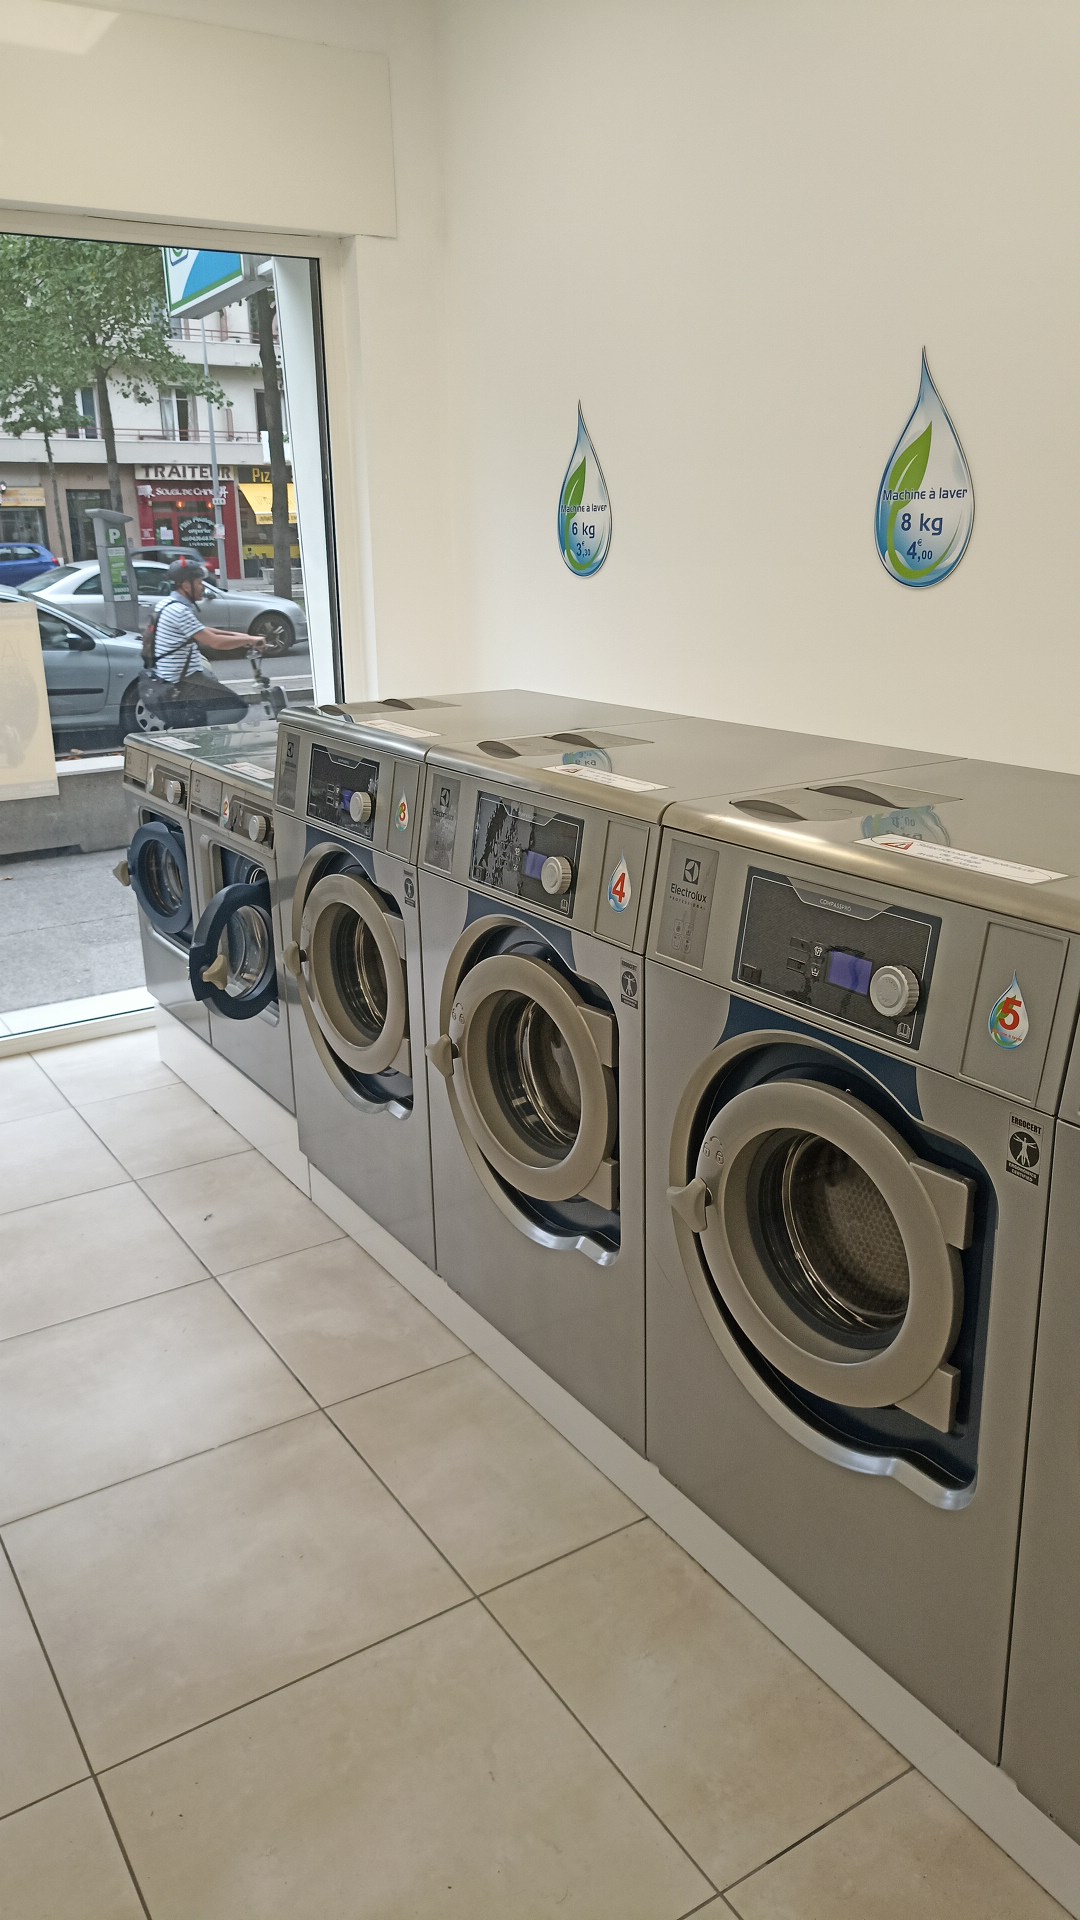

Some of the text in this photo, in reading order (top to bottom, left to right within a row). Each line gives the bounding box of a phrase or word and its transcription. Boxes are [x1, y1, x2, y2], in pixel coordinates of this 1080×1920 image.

[882, 487, 968, 500] Machine à laver
[591, 503, 607, 513] laver
[572, 522, 595, 539] 6 kg
[900, 512, 943, 536] 8 kg
[108, 528, 121, 545] P
[223, 801, 228, 816] 2
[611, 872, 626, 903] 4
[670, 882, 707, 903] Electrolux
[999, 996, 1023, 1031] 5
[1011, 1115, 1042, 1135] ERGOCERT
